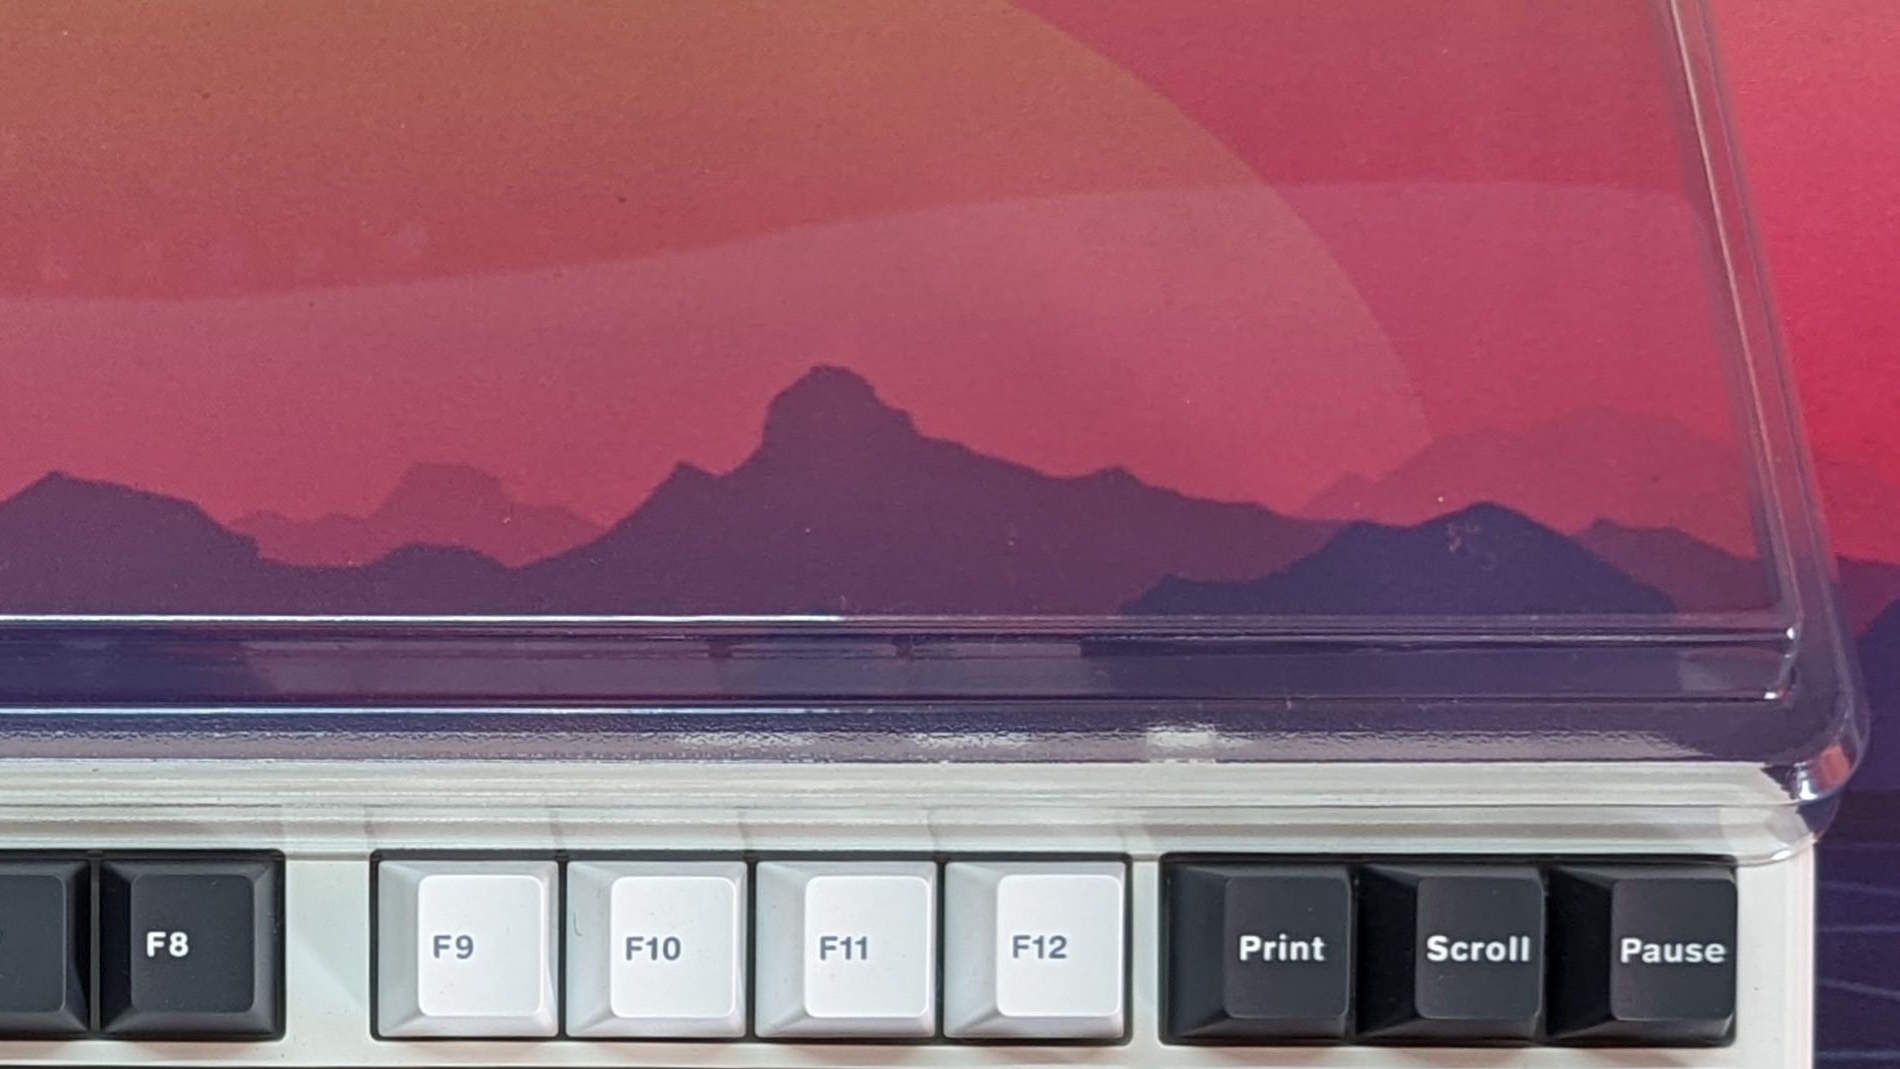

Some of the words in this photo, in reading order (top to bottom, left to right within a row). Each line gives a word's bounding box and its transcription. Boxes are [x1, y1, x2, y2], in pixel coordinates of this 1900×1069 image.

[146, 931, 189, 958] F8
[433, 934, 474, 960] F9
[625, 936, 681, 961] F10
[819, 935, 868, 961] F11
[1012, 934, 1068, 960] F12
[1239, 933, 1325, 961] Print
[1426, 935, 1530, 962] Scroll
[1620, 937, 1726, 964] Pause
